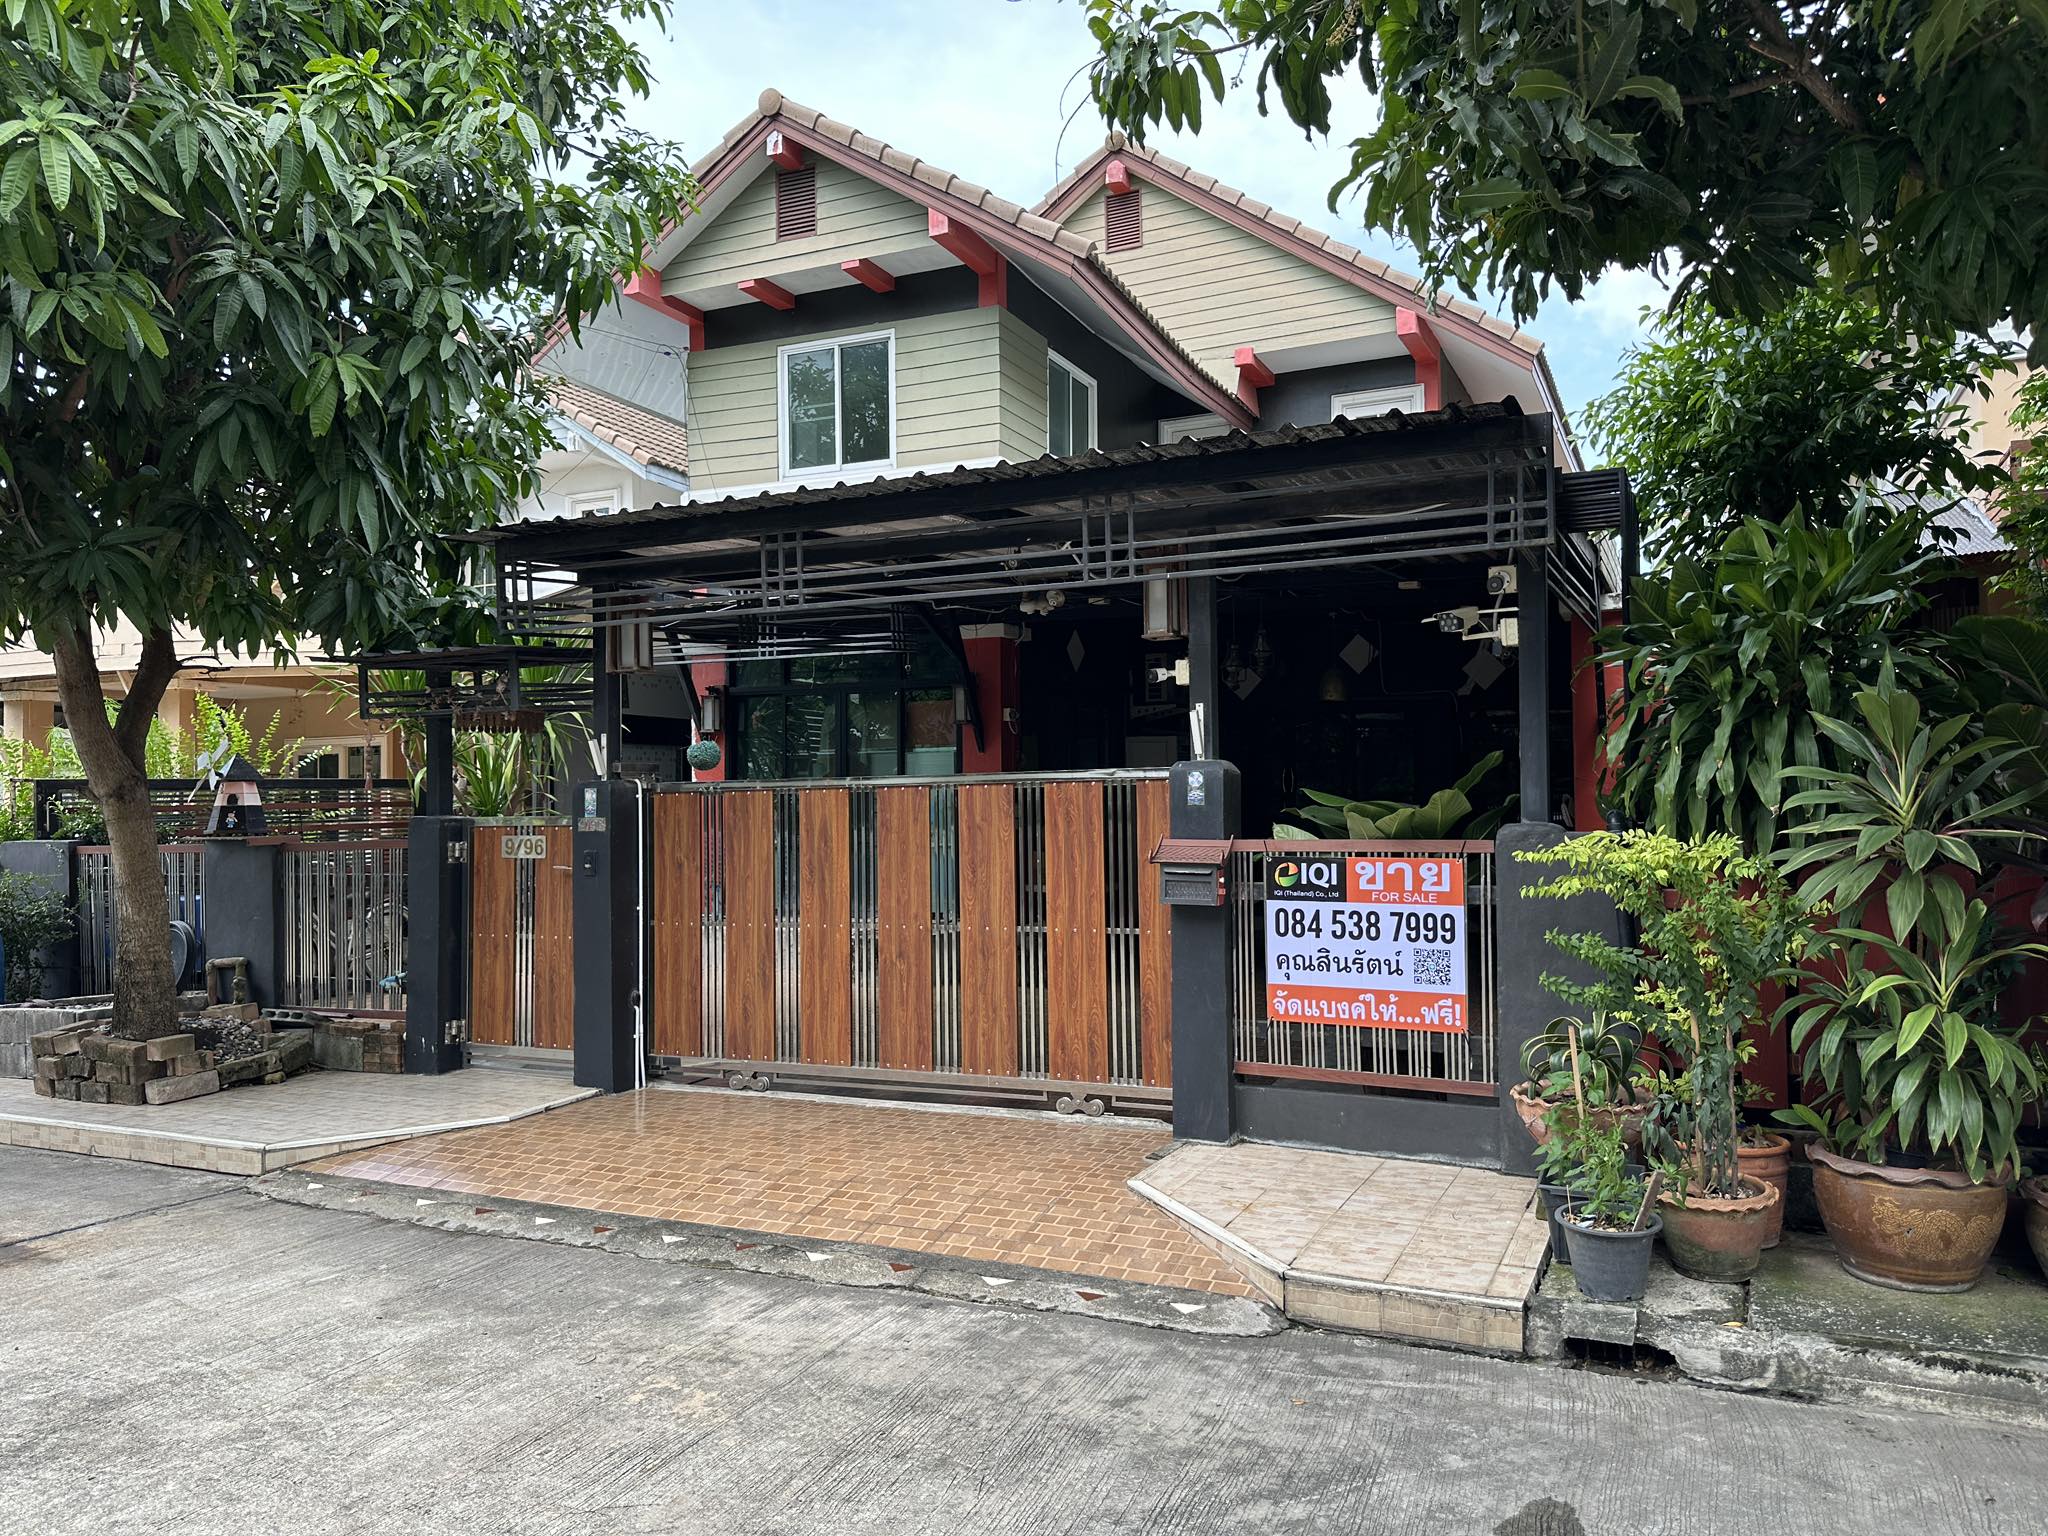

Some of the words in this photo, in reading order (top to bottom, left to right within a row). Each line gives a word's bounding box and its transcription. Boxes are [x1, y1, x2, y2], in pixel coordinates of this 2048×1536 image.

[505, 839, 544, 856] 9/96
[1301, 863, 1337, 888] IQI
[1355, 861, 1450, 892] ขาย
[1284, 890, 1314, 898] (Thailand)
[1372, 891, 1399, 902] FOR
[1403, 892, 1437, 903] SALE
[1275, 907, 1322, 939] 084
[1332, 910, 1380, 941] 538
[1390, 912, 1456, 944] 7999
[1276, 947, 1404, 981] คุณสินรัตน์
[1272, 990, 1461, 1027] จัดแบงค์ให้...ฟรี!
